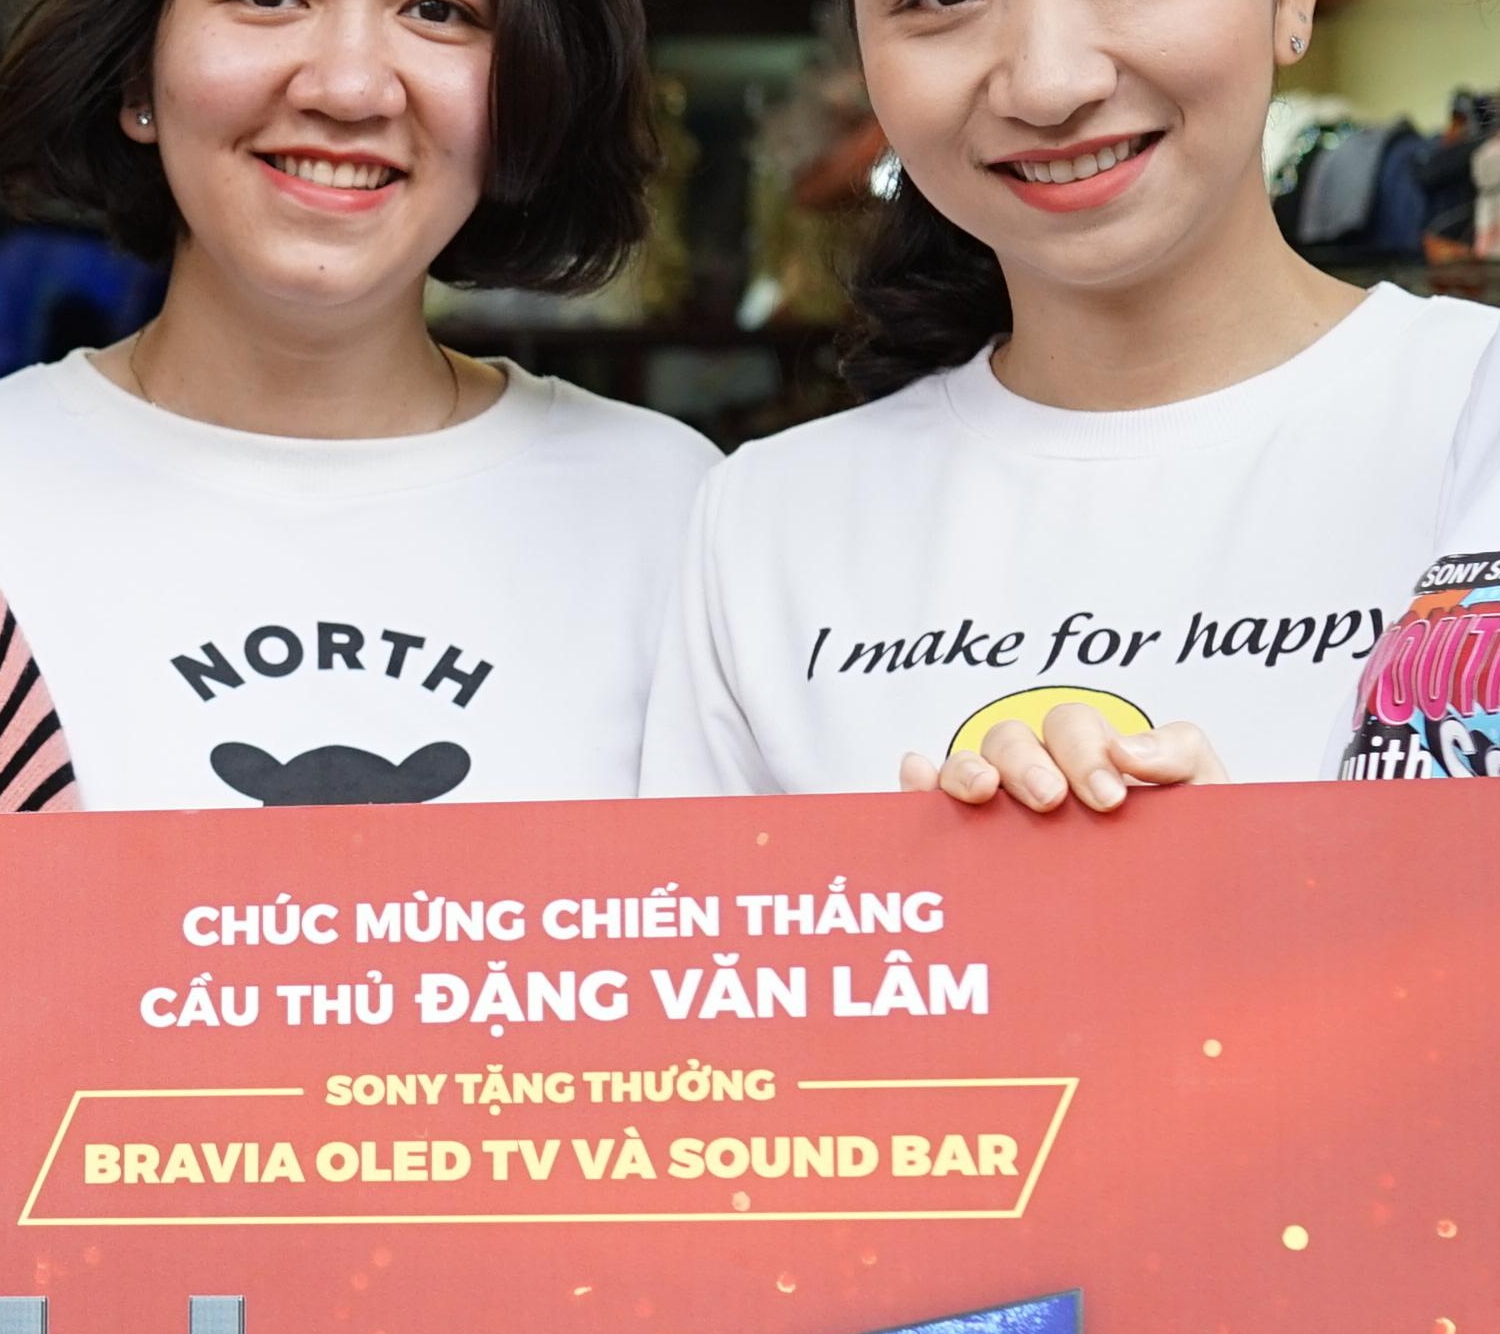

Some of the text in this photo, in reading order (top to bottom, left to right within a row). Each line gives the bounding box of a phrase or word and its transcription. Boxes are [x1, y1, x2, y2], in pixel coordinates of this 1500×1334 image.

[1421, 559, 1488, 588] SONY
[171, 621, 494, 709] NORTH
[807, 608, 1384, 681] I make for happy
[1340, 733, 1434, 781] with
[183, 875, 944, 946] CHÚC MỪNG CHIẾN THẮNG
[140, 950, 989, 1037] CẦU THỦ ĐẶNG VĂN LÂM
[325, 1058, 776, 1116] SONY TẶNG THƯỞNG
[84, 1127, 1019, 1184] BRAVIA OLED TV VÀ SOUND BAR
